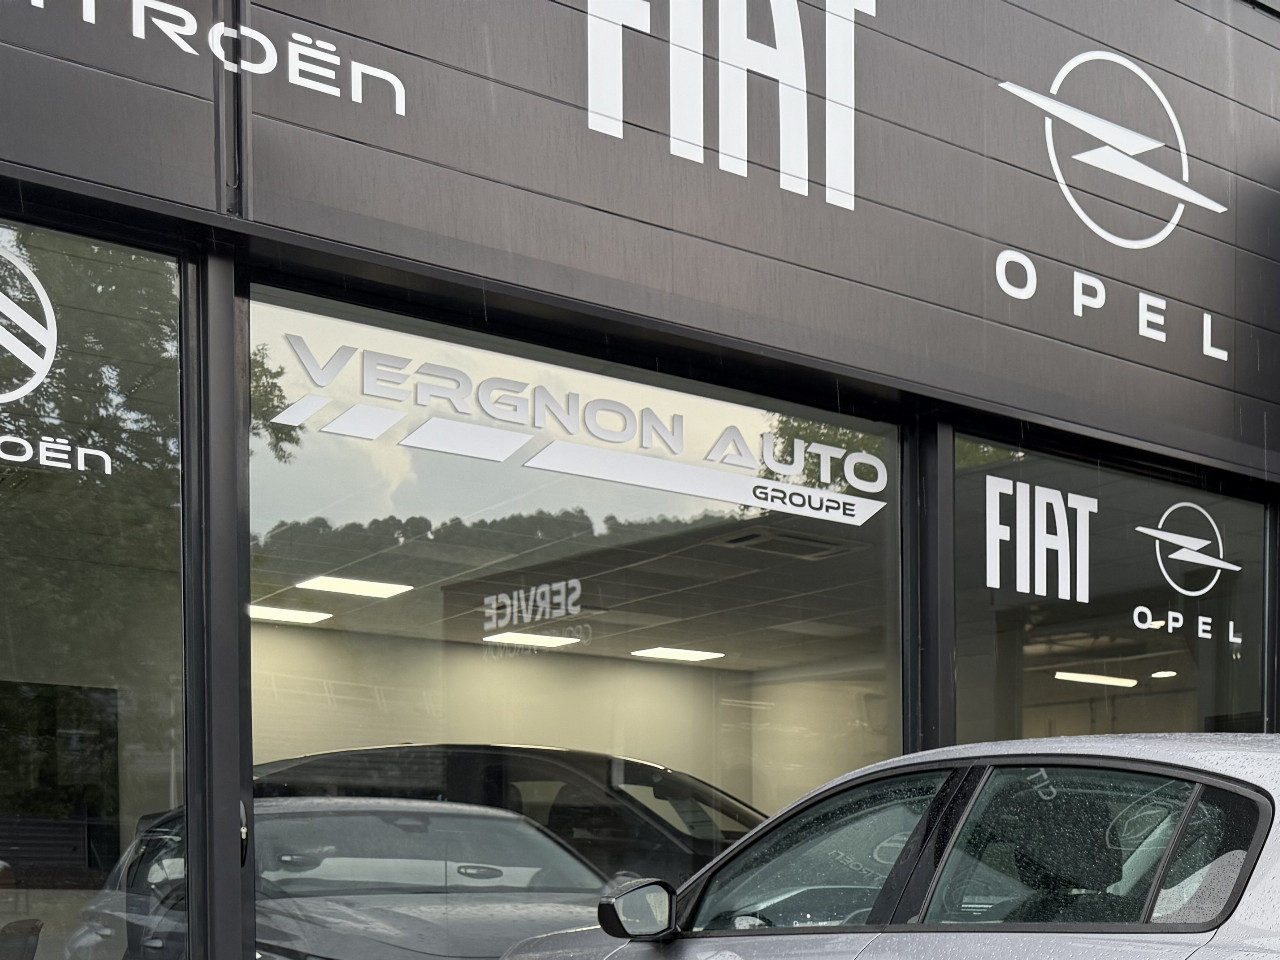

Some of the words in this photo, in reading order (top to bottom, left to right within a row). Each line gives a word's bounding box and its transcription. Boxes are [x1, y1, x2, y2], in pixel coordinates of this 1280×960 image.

[995, 249, 1229, 362] OPEL
[285, 333, 684, 456] VERGNON
[704, 424, 888, 494] AUTO
[752, 485, 857, 518] GROUPE
[986, 474, 1098, 604] FIAT
[1132, 605, 1243, 644] OPEL
